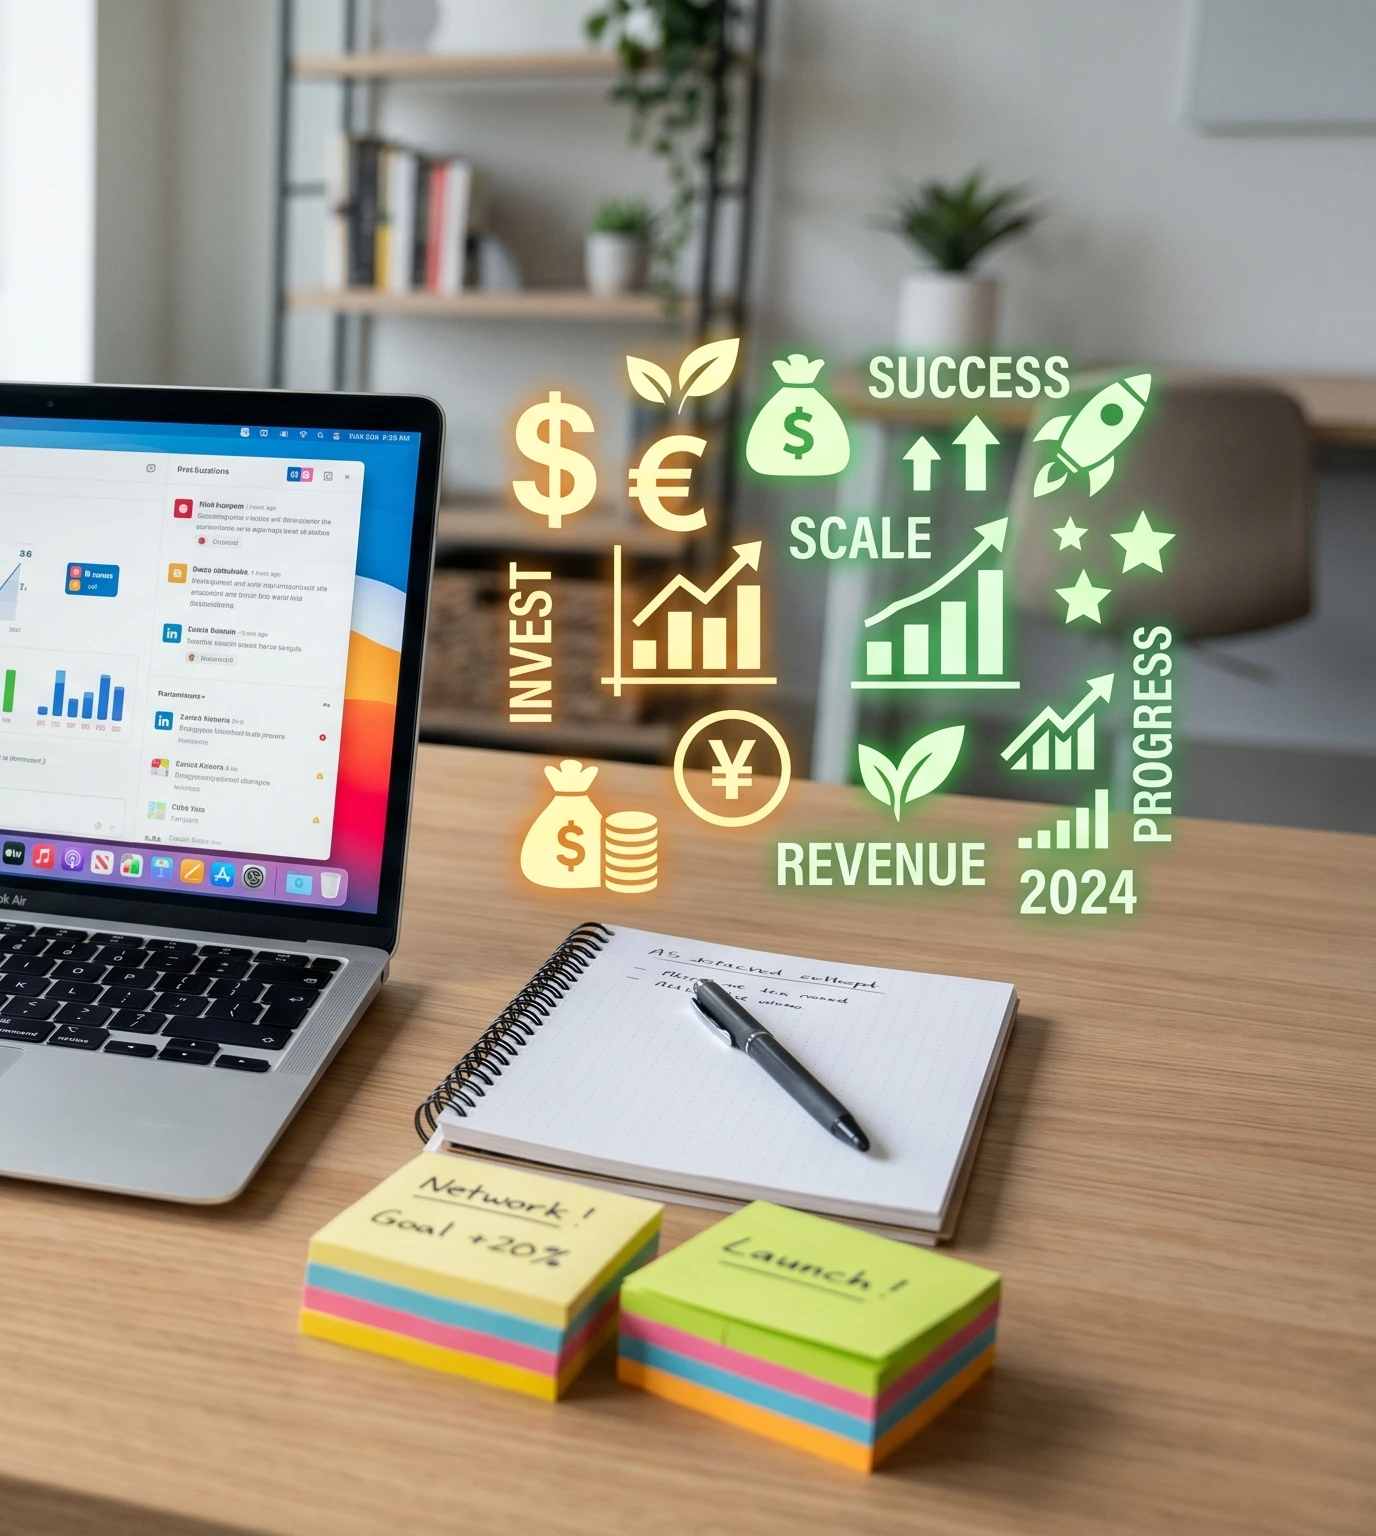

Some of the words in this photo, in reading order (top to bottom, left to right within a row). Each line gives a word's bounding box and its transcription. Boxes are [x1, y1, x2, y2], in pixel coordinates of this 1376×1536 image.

[11, 894, 28, 907] Air
[370, 1208, 454, 1238] Goal
[467, 1233, 570, 1268] +20%
